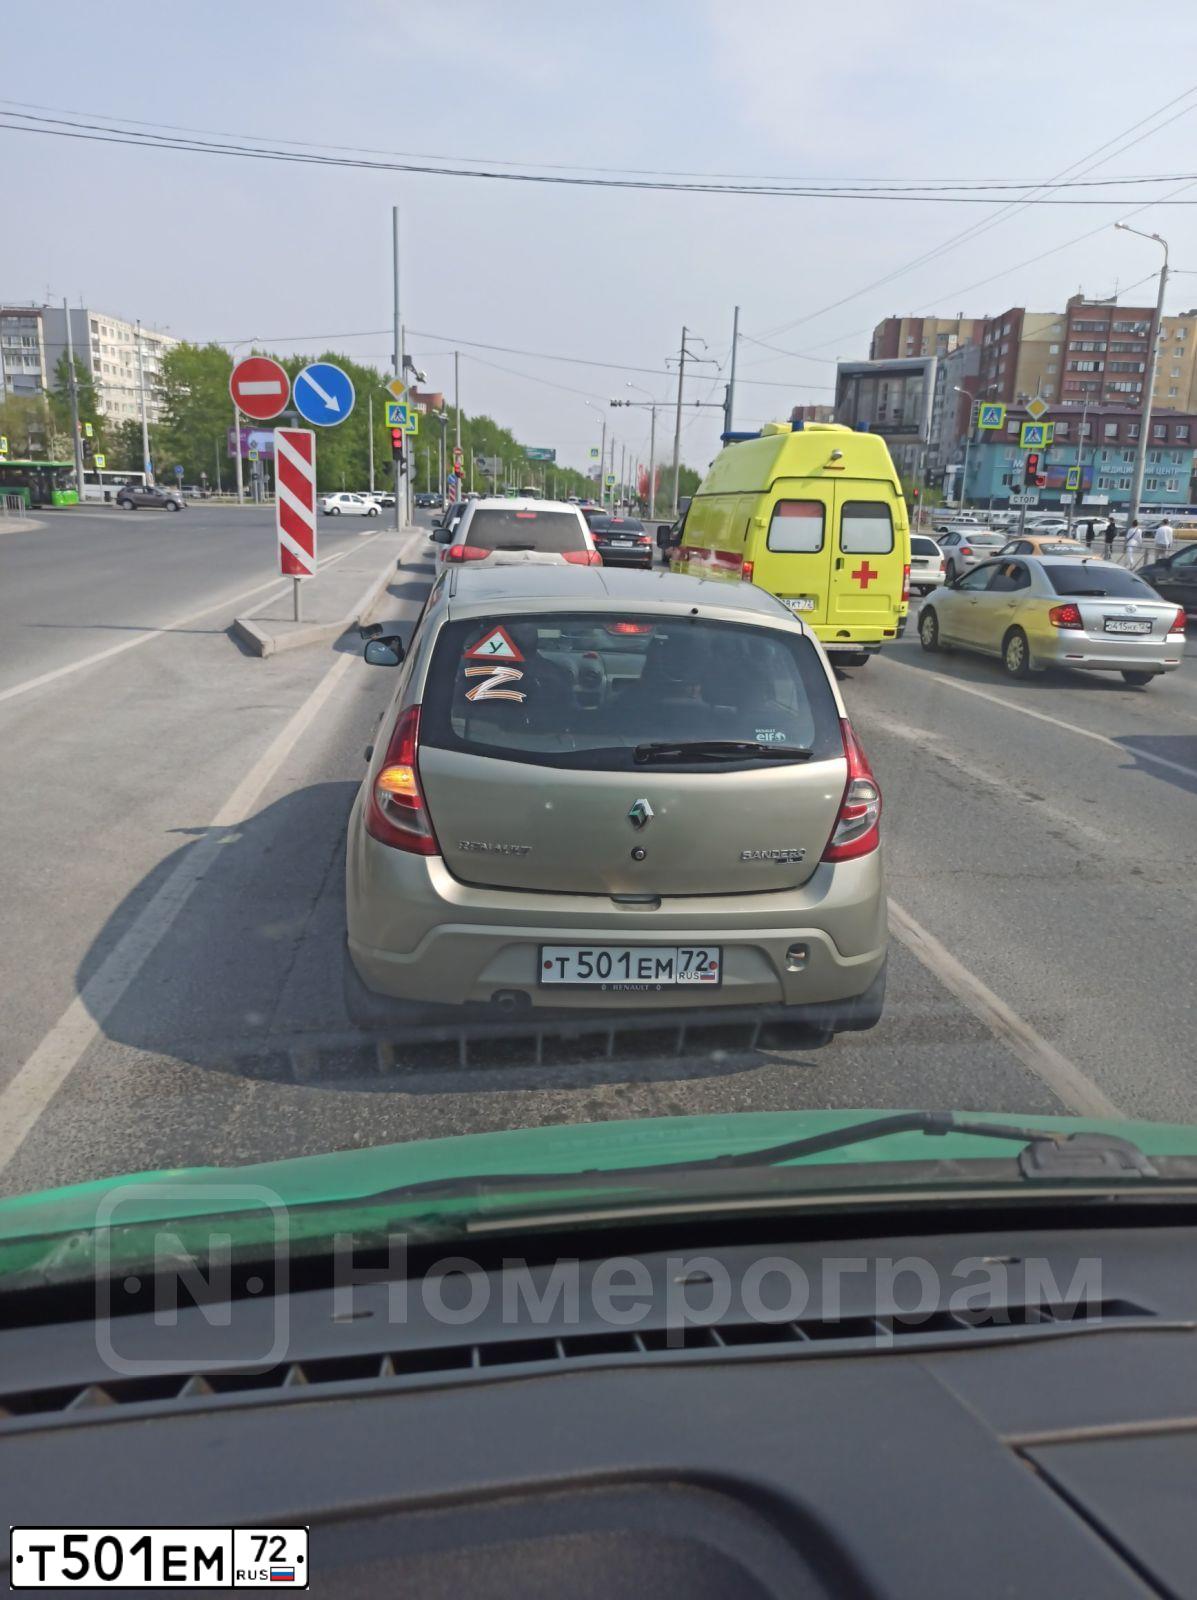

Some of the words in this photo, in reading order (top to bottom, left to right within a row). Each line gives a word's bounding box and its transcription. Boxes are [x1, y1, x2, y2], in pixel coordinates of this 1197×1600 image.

[489, 641, 504, 654] У
[464, 665, 527, 703] Z
[756, 733, 774, 741] elf
[742, 848, 806, 860] SANDERO
[555, 951, 673, 979] Т501ЕМ
[681, 950, 708, 971] 72
[678, 972, 700, 980] RUS
